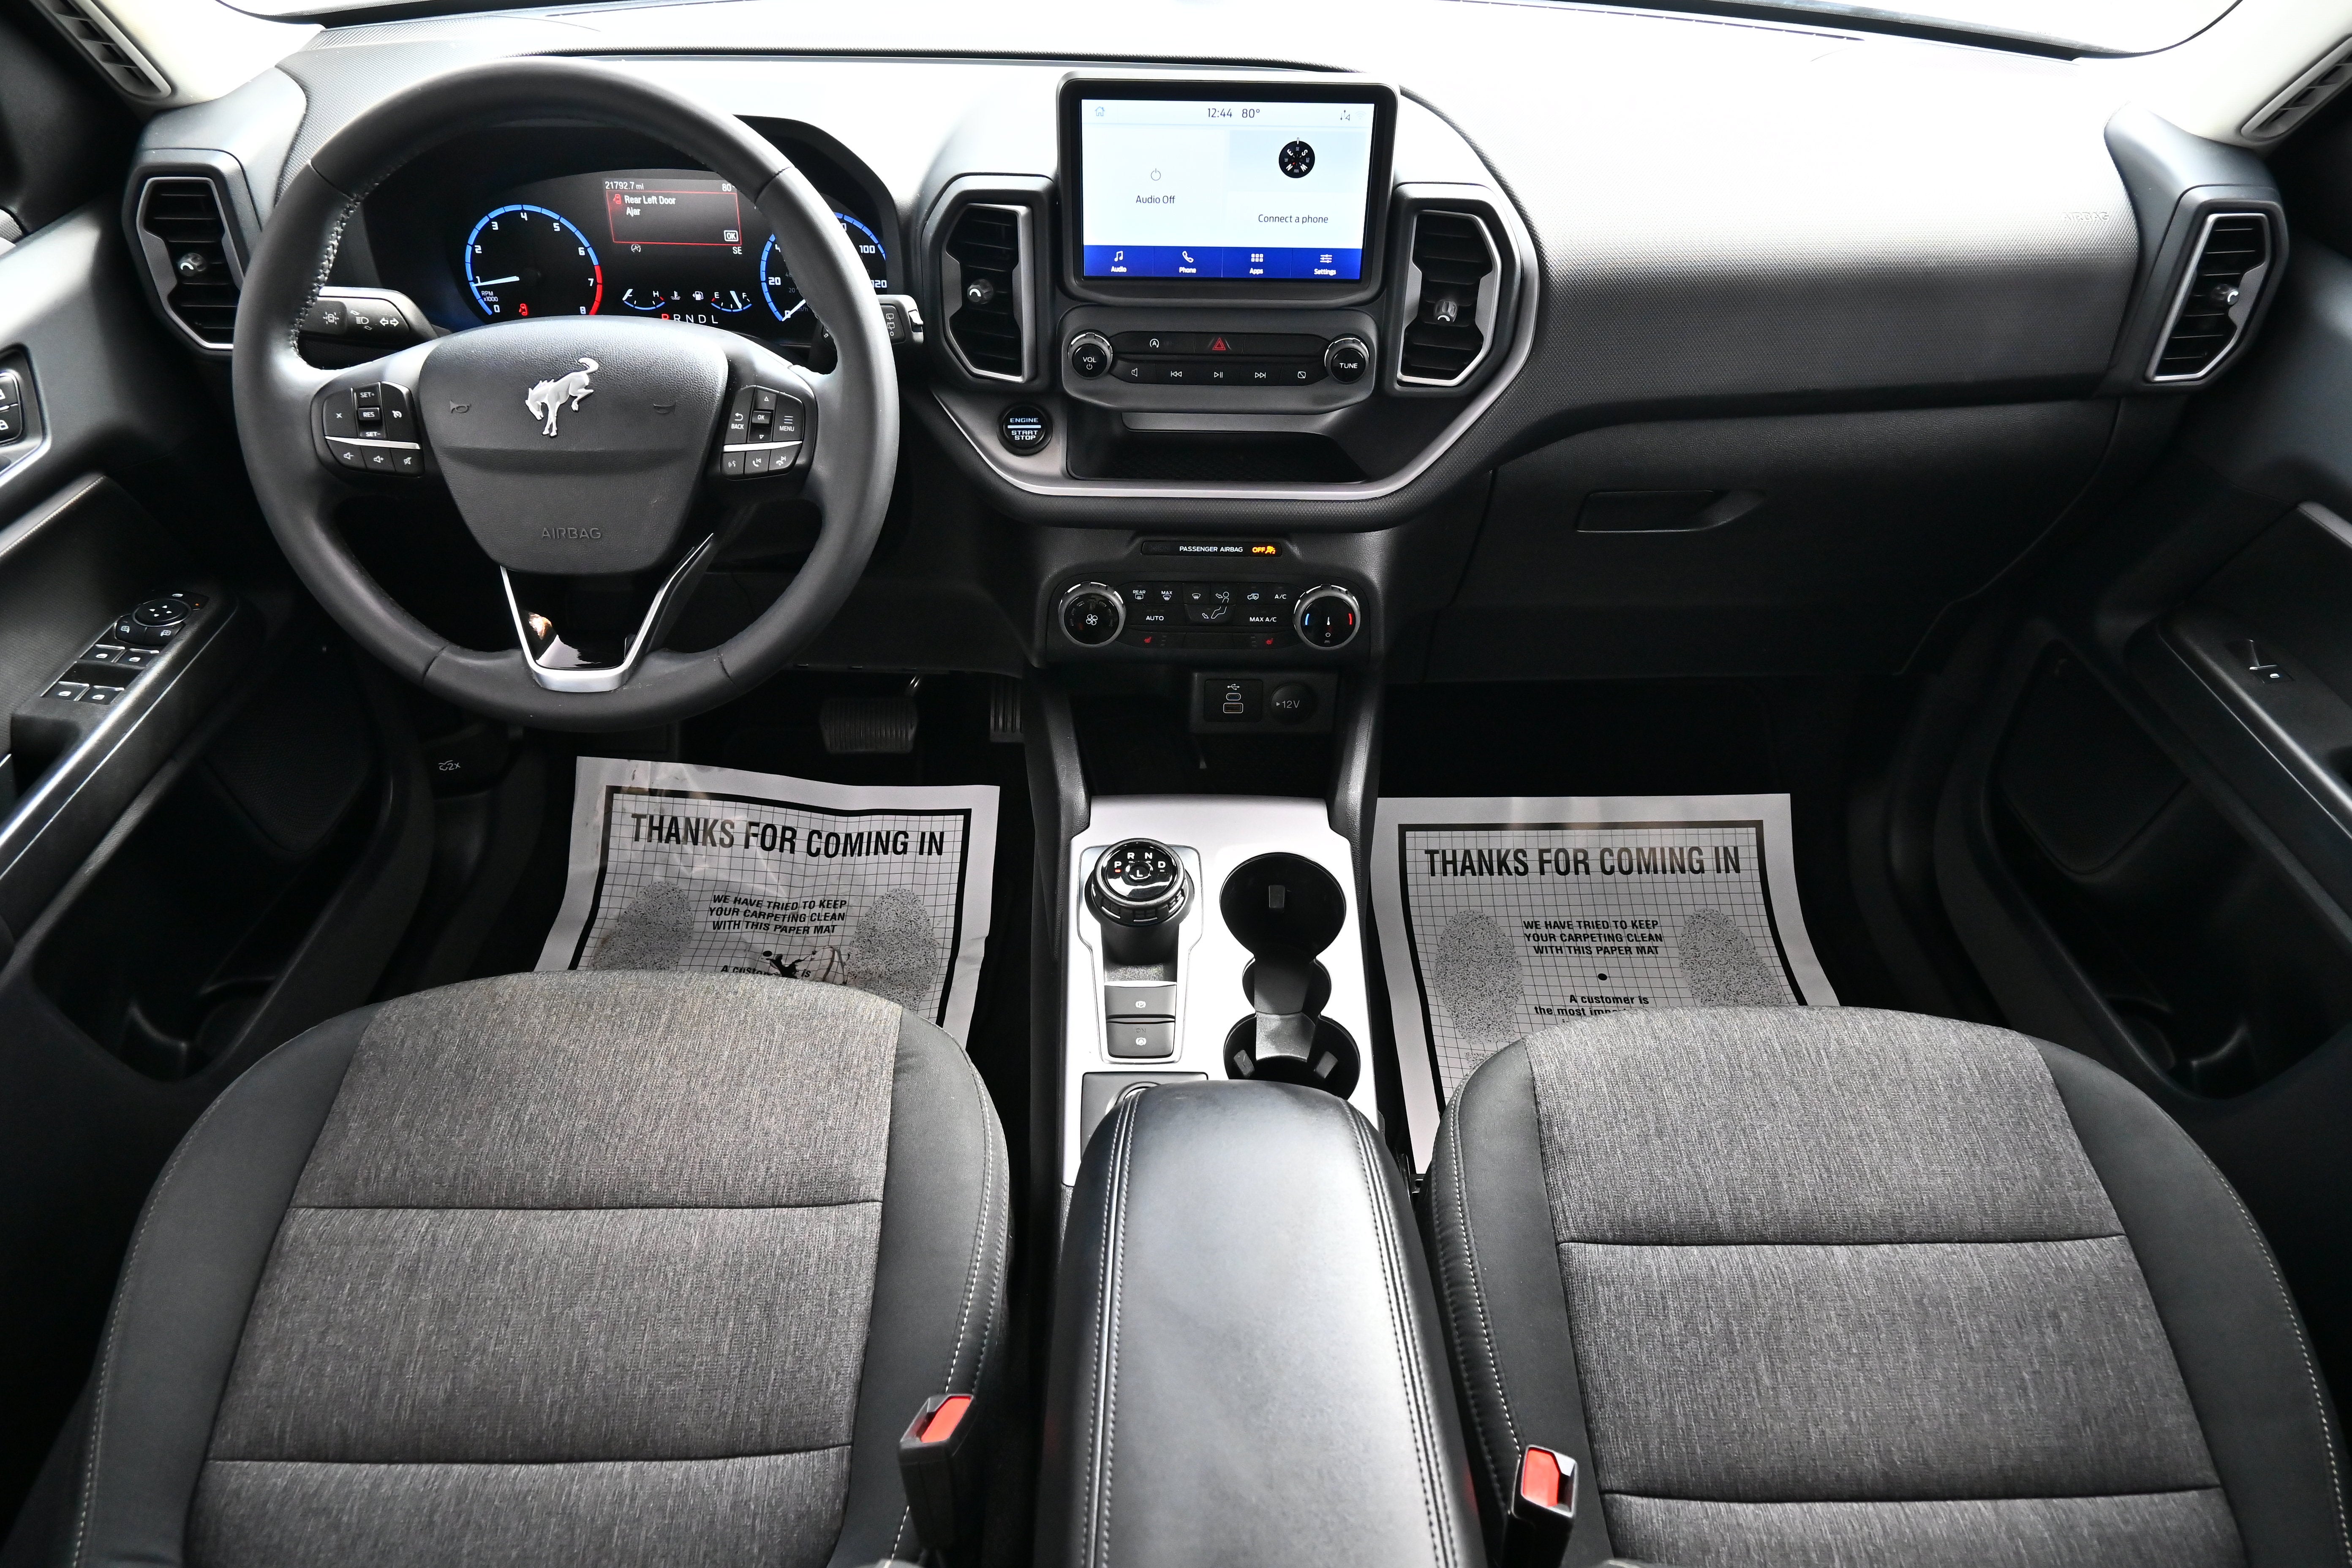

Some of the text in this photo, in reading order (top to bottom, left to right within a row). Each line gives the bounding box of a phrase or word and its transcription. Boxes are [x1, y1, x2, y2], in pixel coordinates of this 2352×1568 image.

[1208, 108, 1260, 118] 12:44 80°
[605, 181, 634, 190] 21792.7
[624, 195, 676, 205] Rear Left Door
[1136, 195, 1176, 204] Audio Off
[520, 212, 528, 220] 4
[626, 207, 641, 217] Ajar
[1258, 214, 1293, 223] Connect
[1302, 215, 1328, 224] phone
[491, 222, 498, 230] 3
[553, 223, 560, 231] 5
[474, 245, 482, 253] 2
[578, 247, 585, 256] 6
[733, 246, 742, 254] SE
[859, 245, 876, 253] 100
[588, 278, 594, 286] 7
[768, 277, 781, 286] 20
[493, 305, 500, 313] 0
[580, 306, 586, 314] 8
[673, 314, 681, 322] R
[686, 314, 694, 323] N
[698, 315, 706, 323] D
[712, 315, 718, 324] L
[542, 528, 602, 539] AIRBAG
[1282, 700, 1300, 709] 12V
[447, 762, 461, 770] 2x
[631, 813, 945, 858] THANKS FOR COMING IN
[1425, 846, 1741, 877] THANKS FOR COMING IN
[1136, 869, 1143, 877] L
[713, 894, 847, 911] WE HAVE TRIED TO KEEP
[709, 907, 845, 923] YOUR CARPETING CLEAN
[713, 920, 837, 935] WITH THIS PAPER MAT
[1523, 920, 1658, 929] WE HAVE TRIED TO KEEP
[1524, 933, 1663, 942] YOUR CARPETING CLEAN
[1533, 946, 1659, 955] WITH THIS PAPER MAT
[801, 969, 811, 977] is
[1569, 994, 1649, 1004] A customer is
[1534, 1006, 1553, 1015] the
[1557, 1007, 1586, 1015] most
